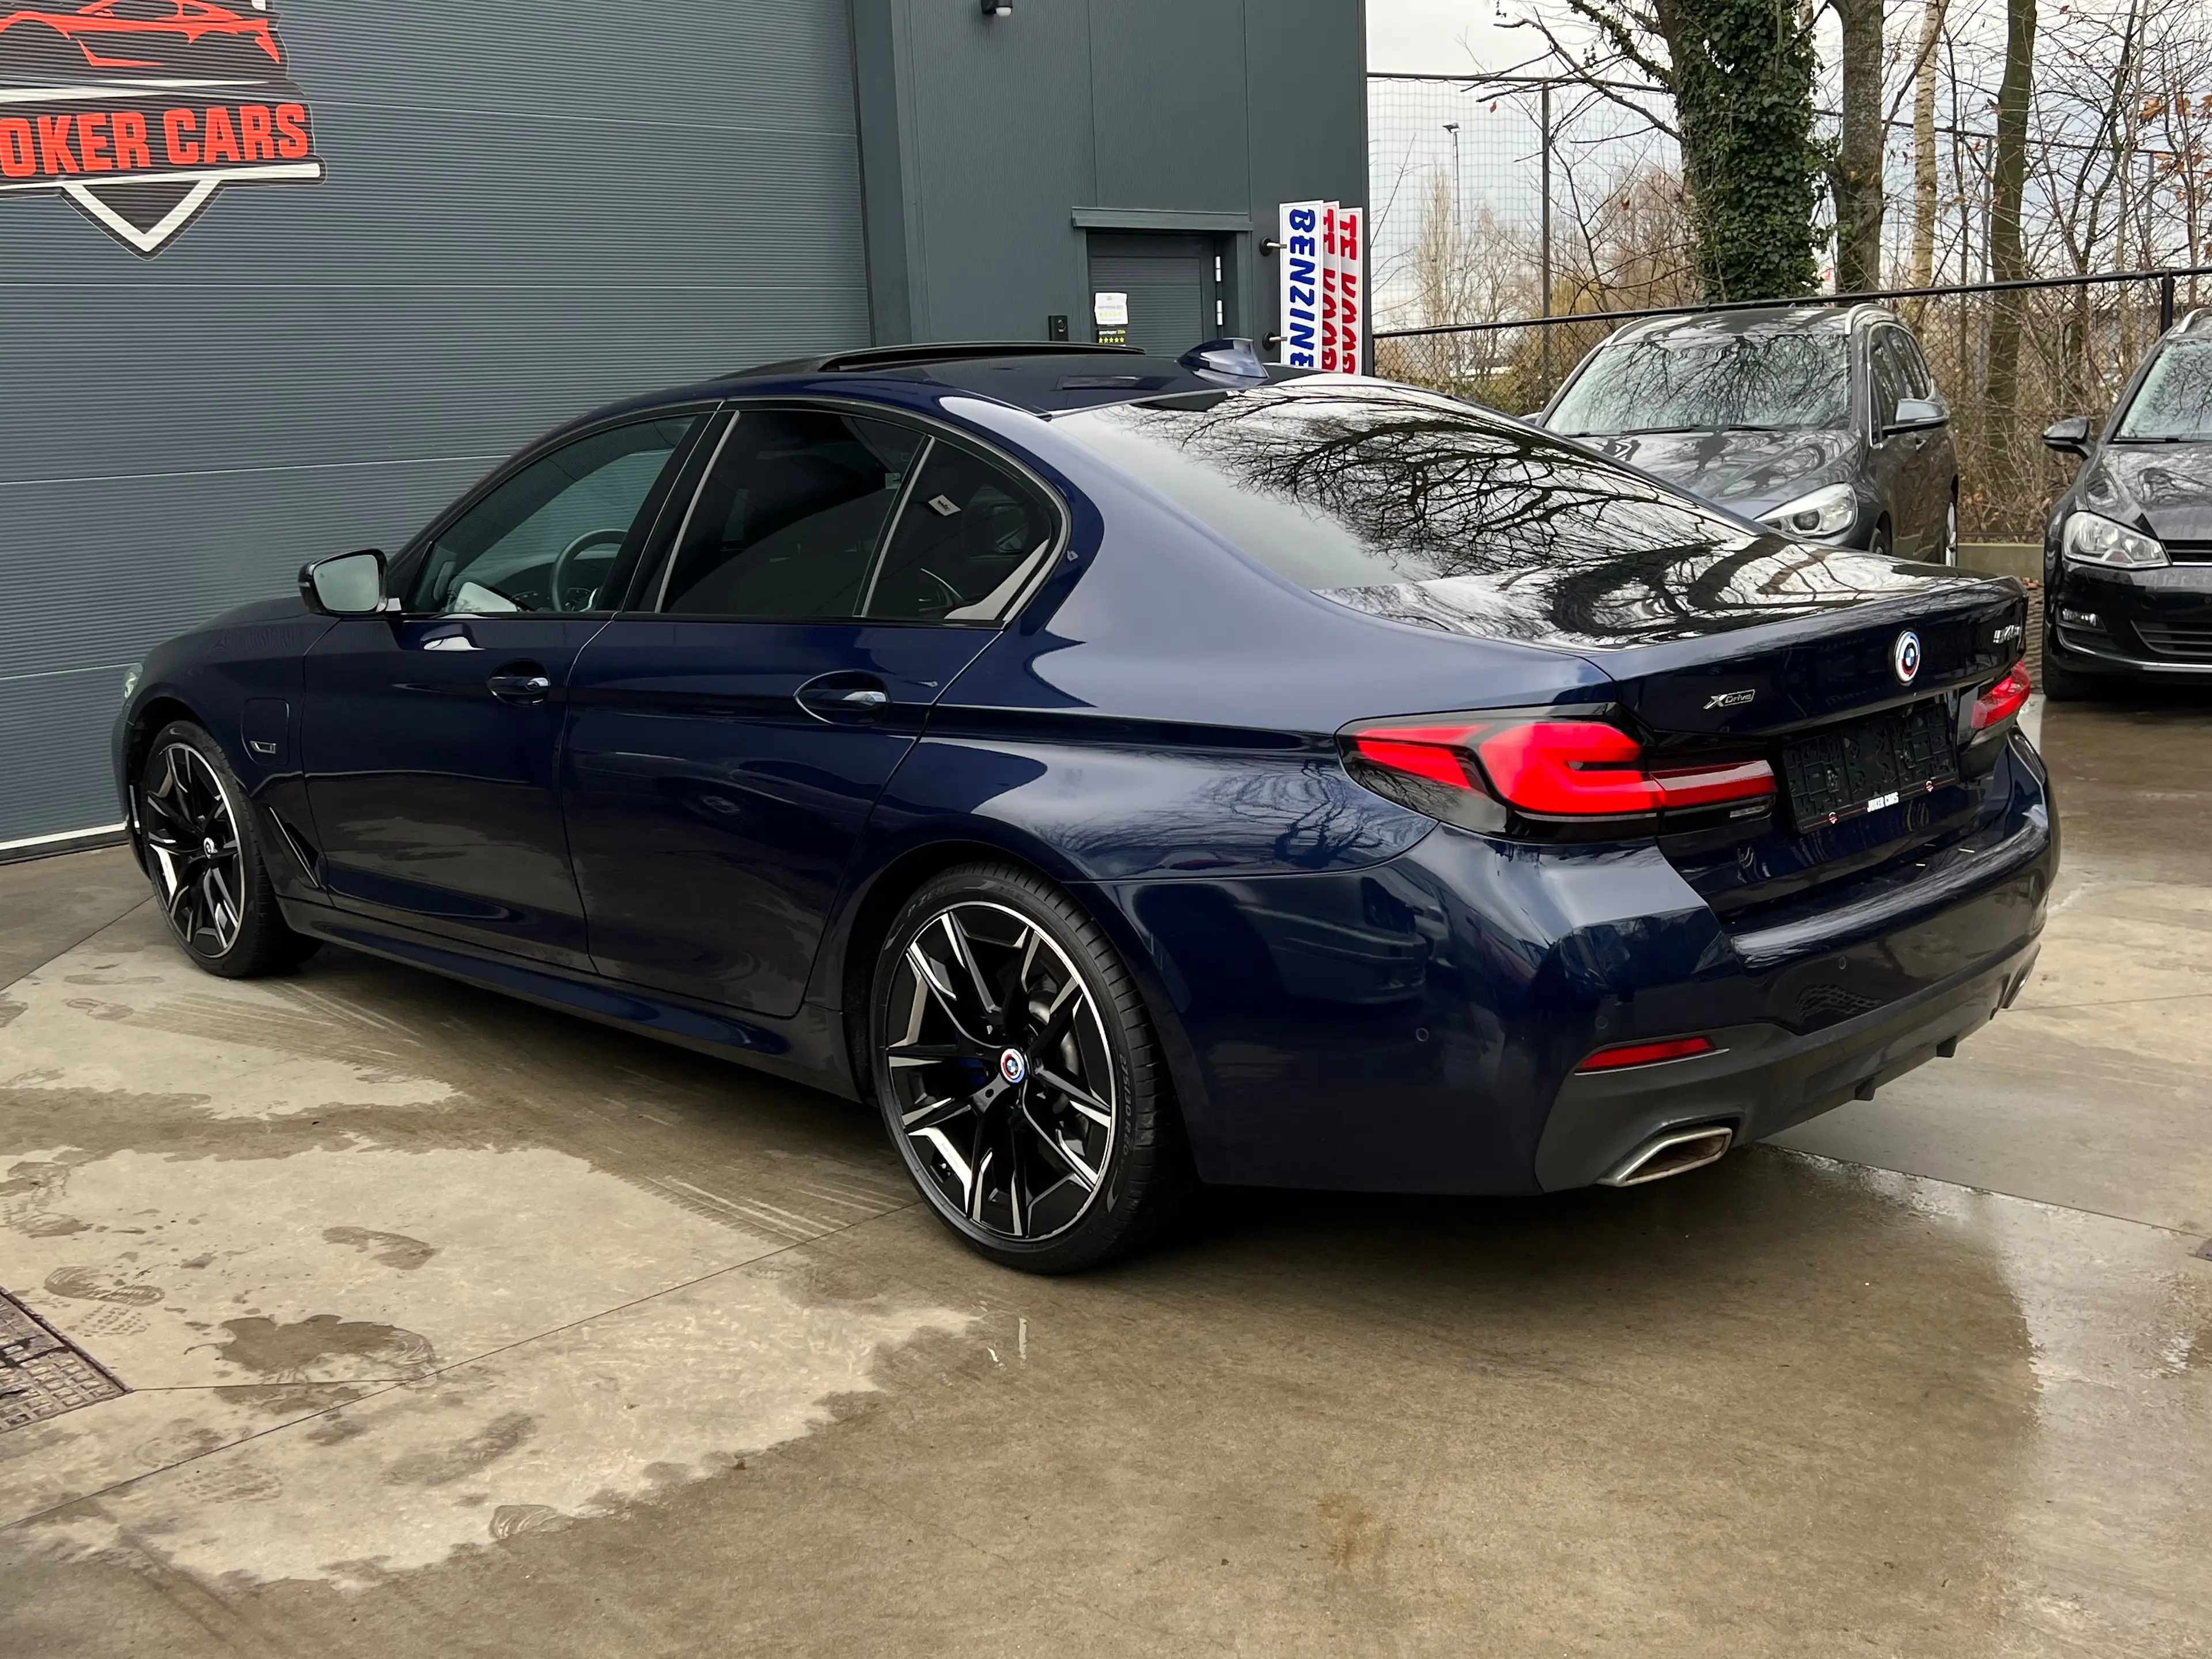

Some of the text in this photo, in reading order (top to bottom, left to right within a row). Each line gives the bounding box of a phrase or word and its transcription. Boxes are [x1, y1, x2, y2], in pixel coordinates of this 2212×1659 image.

[164, 103, 308, 164] CARS
[1290, 209, 1316, 368] BENZINE
[1119, 1053, 1131, 1117] 275/30
